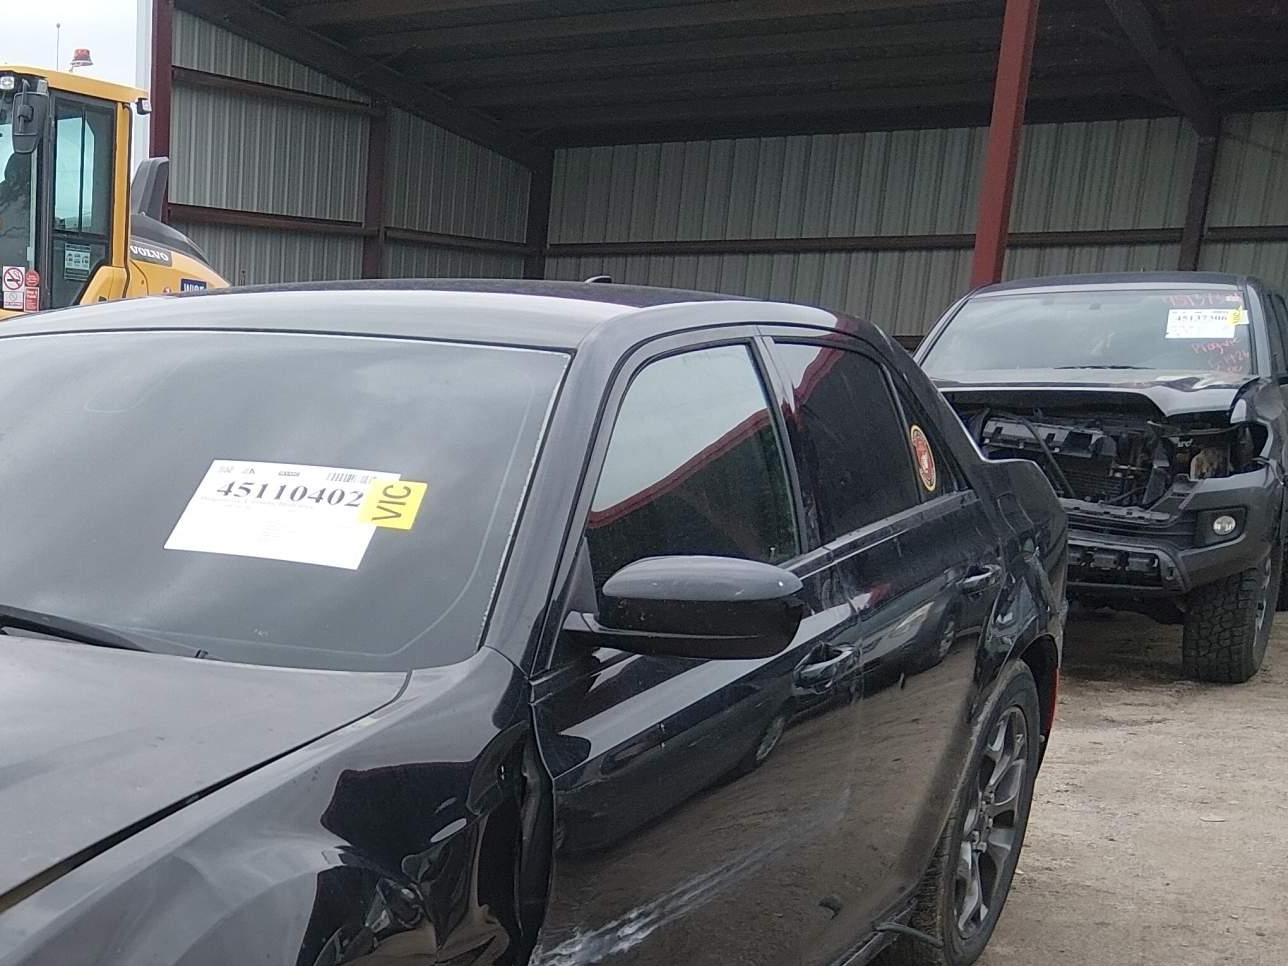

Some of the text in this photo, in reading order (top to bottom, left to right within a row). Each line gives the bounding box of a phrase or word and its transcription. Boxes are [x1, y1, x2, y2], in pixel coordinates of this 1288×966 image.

[129, 245, 169, 262] VOLVO
[216, 480, 366, 507] 45110402
[372, 484, 412, 521] VIC
